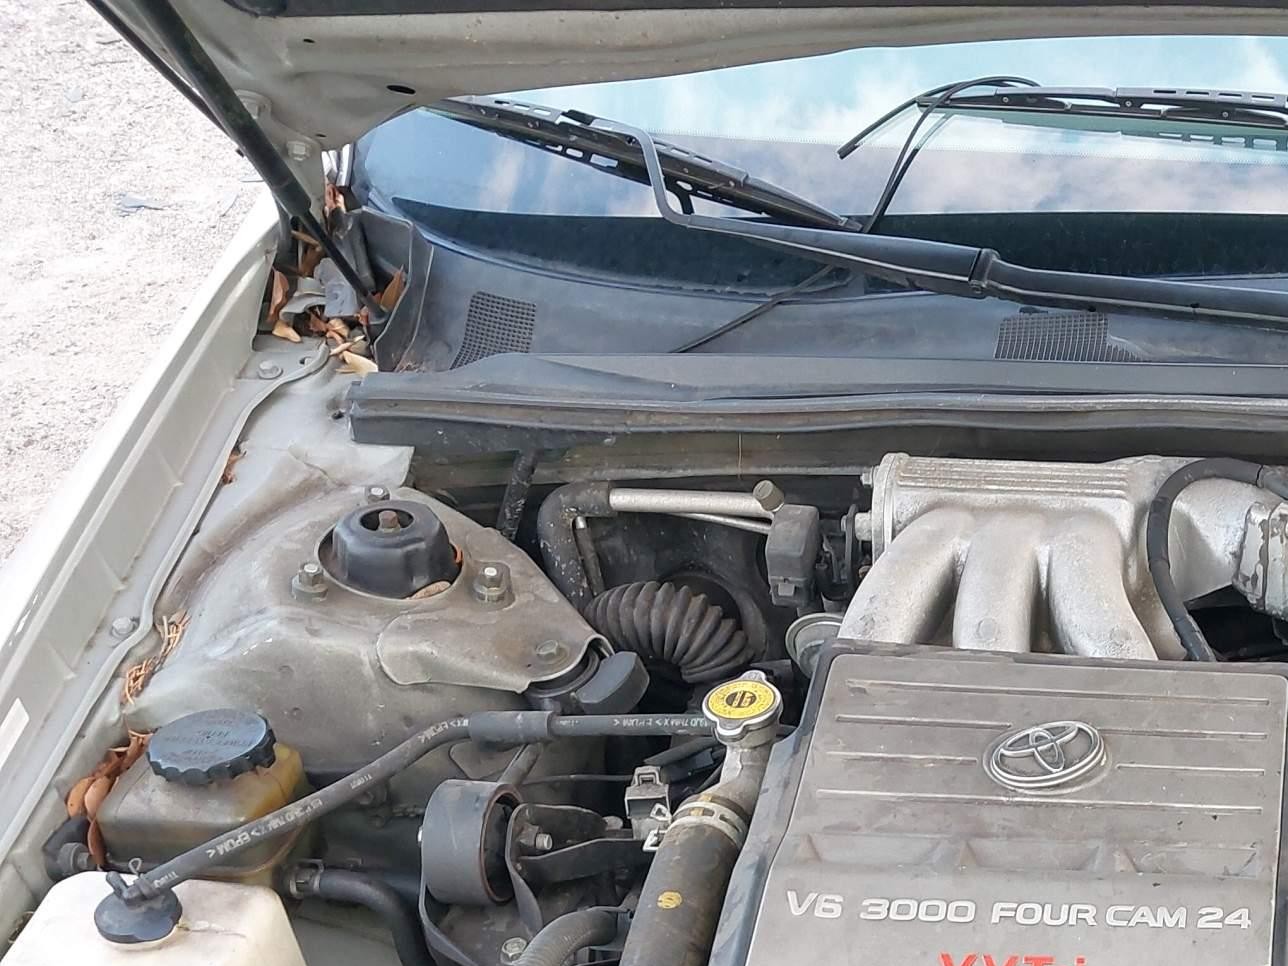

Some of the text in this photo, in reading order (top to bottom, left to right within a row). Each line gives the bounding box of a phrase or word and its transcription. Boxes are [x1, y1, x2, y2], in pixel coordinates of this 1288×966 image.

[785, 889, 1252, 930] V6 3000 FOUR CAM 24
